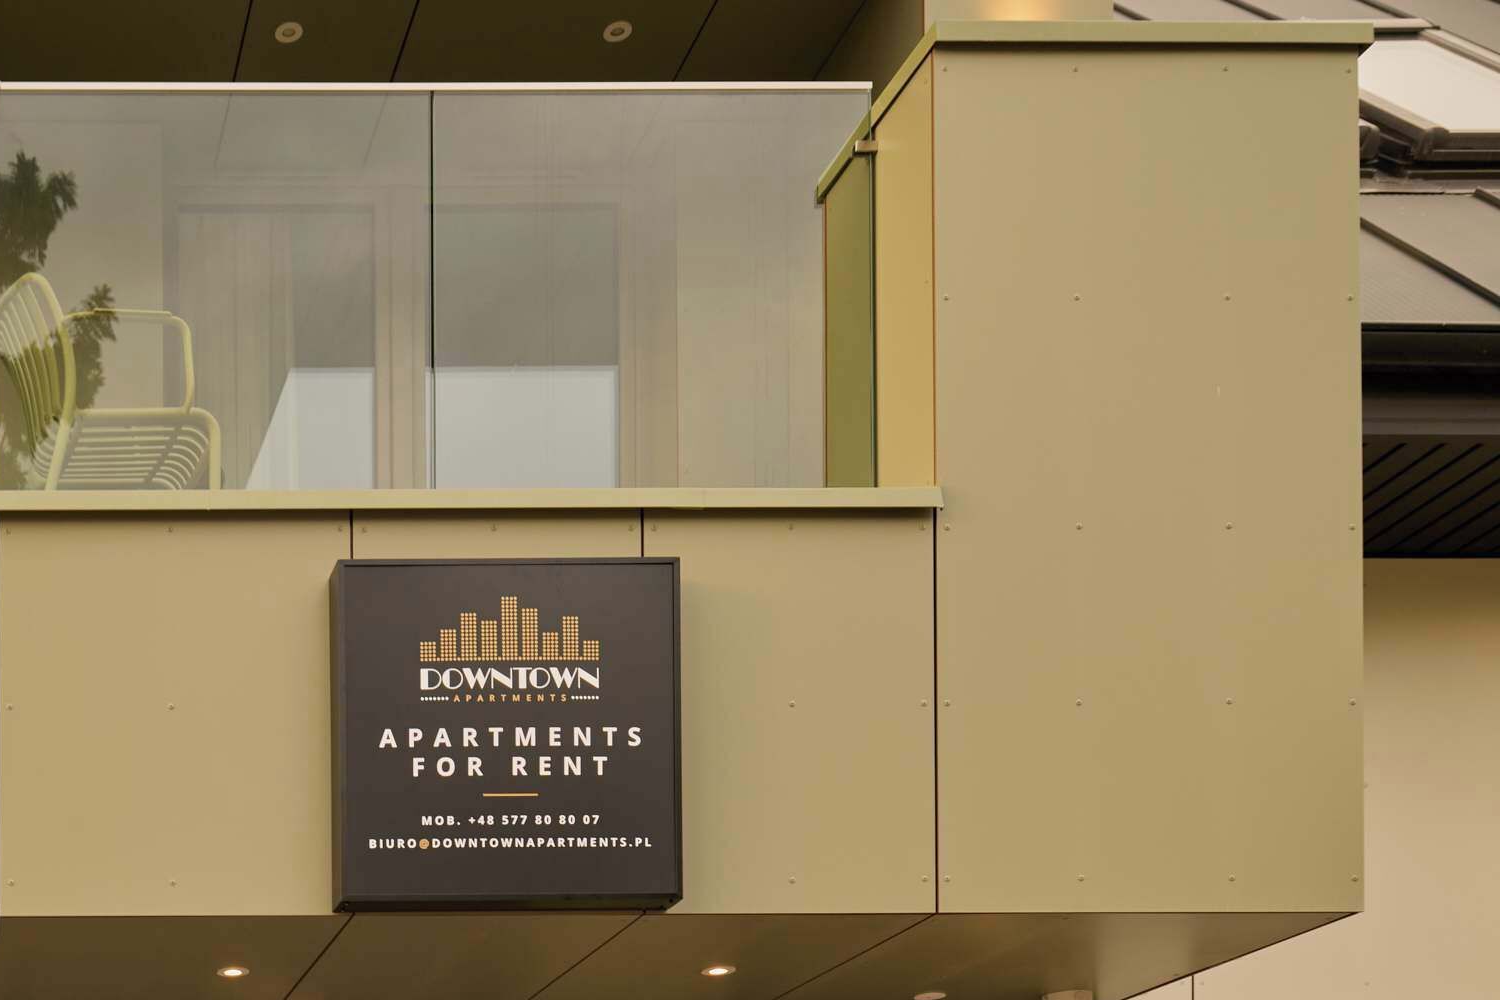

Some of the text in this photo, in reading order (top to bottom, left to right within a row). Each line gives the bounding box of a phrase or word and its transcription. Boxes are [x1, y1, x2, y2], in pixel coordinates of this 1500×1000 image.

[419, 666, 600, 691] DOWNTOWN
[452, 693, 568, 703] APARTMENTS
[378, 726, 642, 749] APARTMENTS
[412, 755, 608, 778] FOR RENT
[421, 814, 600, 827] MOB. +48 577 80 80 07
[368, 836, 653, 850] BIURO@DOWNTOWNAPARTMENTS.PL
